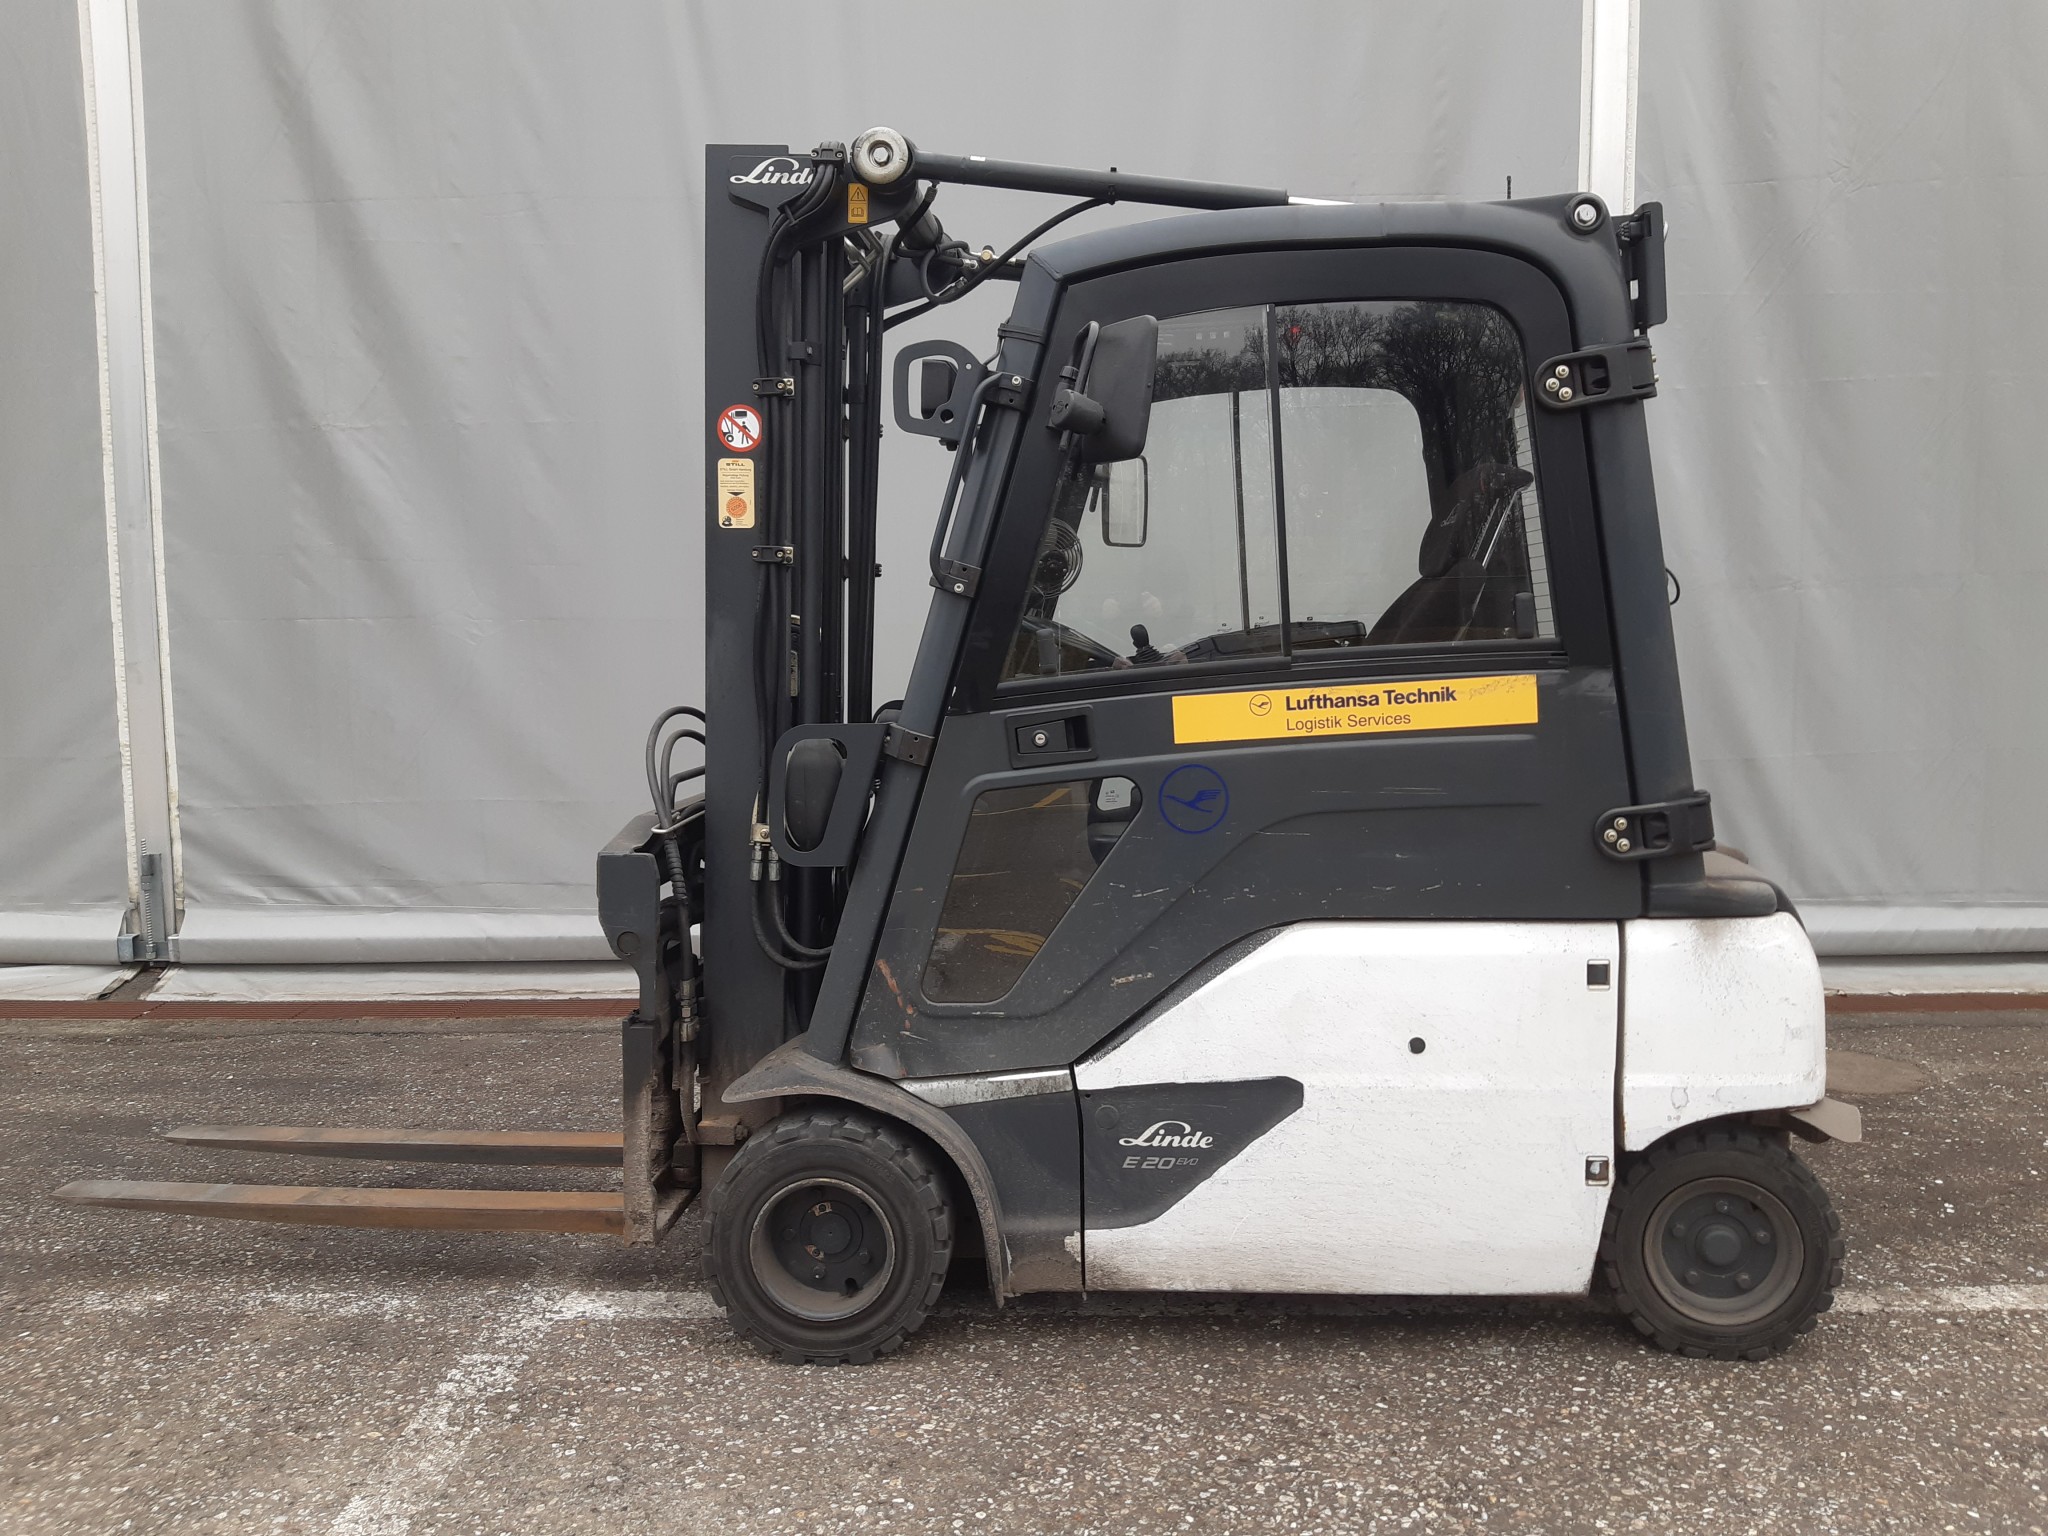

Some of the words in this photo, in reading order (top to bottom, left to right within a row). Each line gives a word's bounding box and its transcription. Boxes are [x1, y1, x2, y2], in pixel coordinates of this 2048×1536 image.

[1285, 691, 1380, 711] Lufthansa
[1383, 686, 1457, 706] Technik
[1286, 714, 1342, 733] Logistik
[1347, 712, 1411, 728] Services
[1118, 1120, 1214, 1148] Linde
